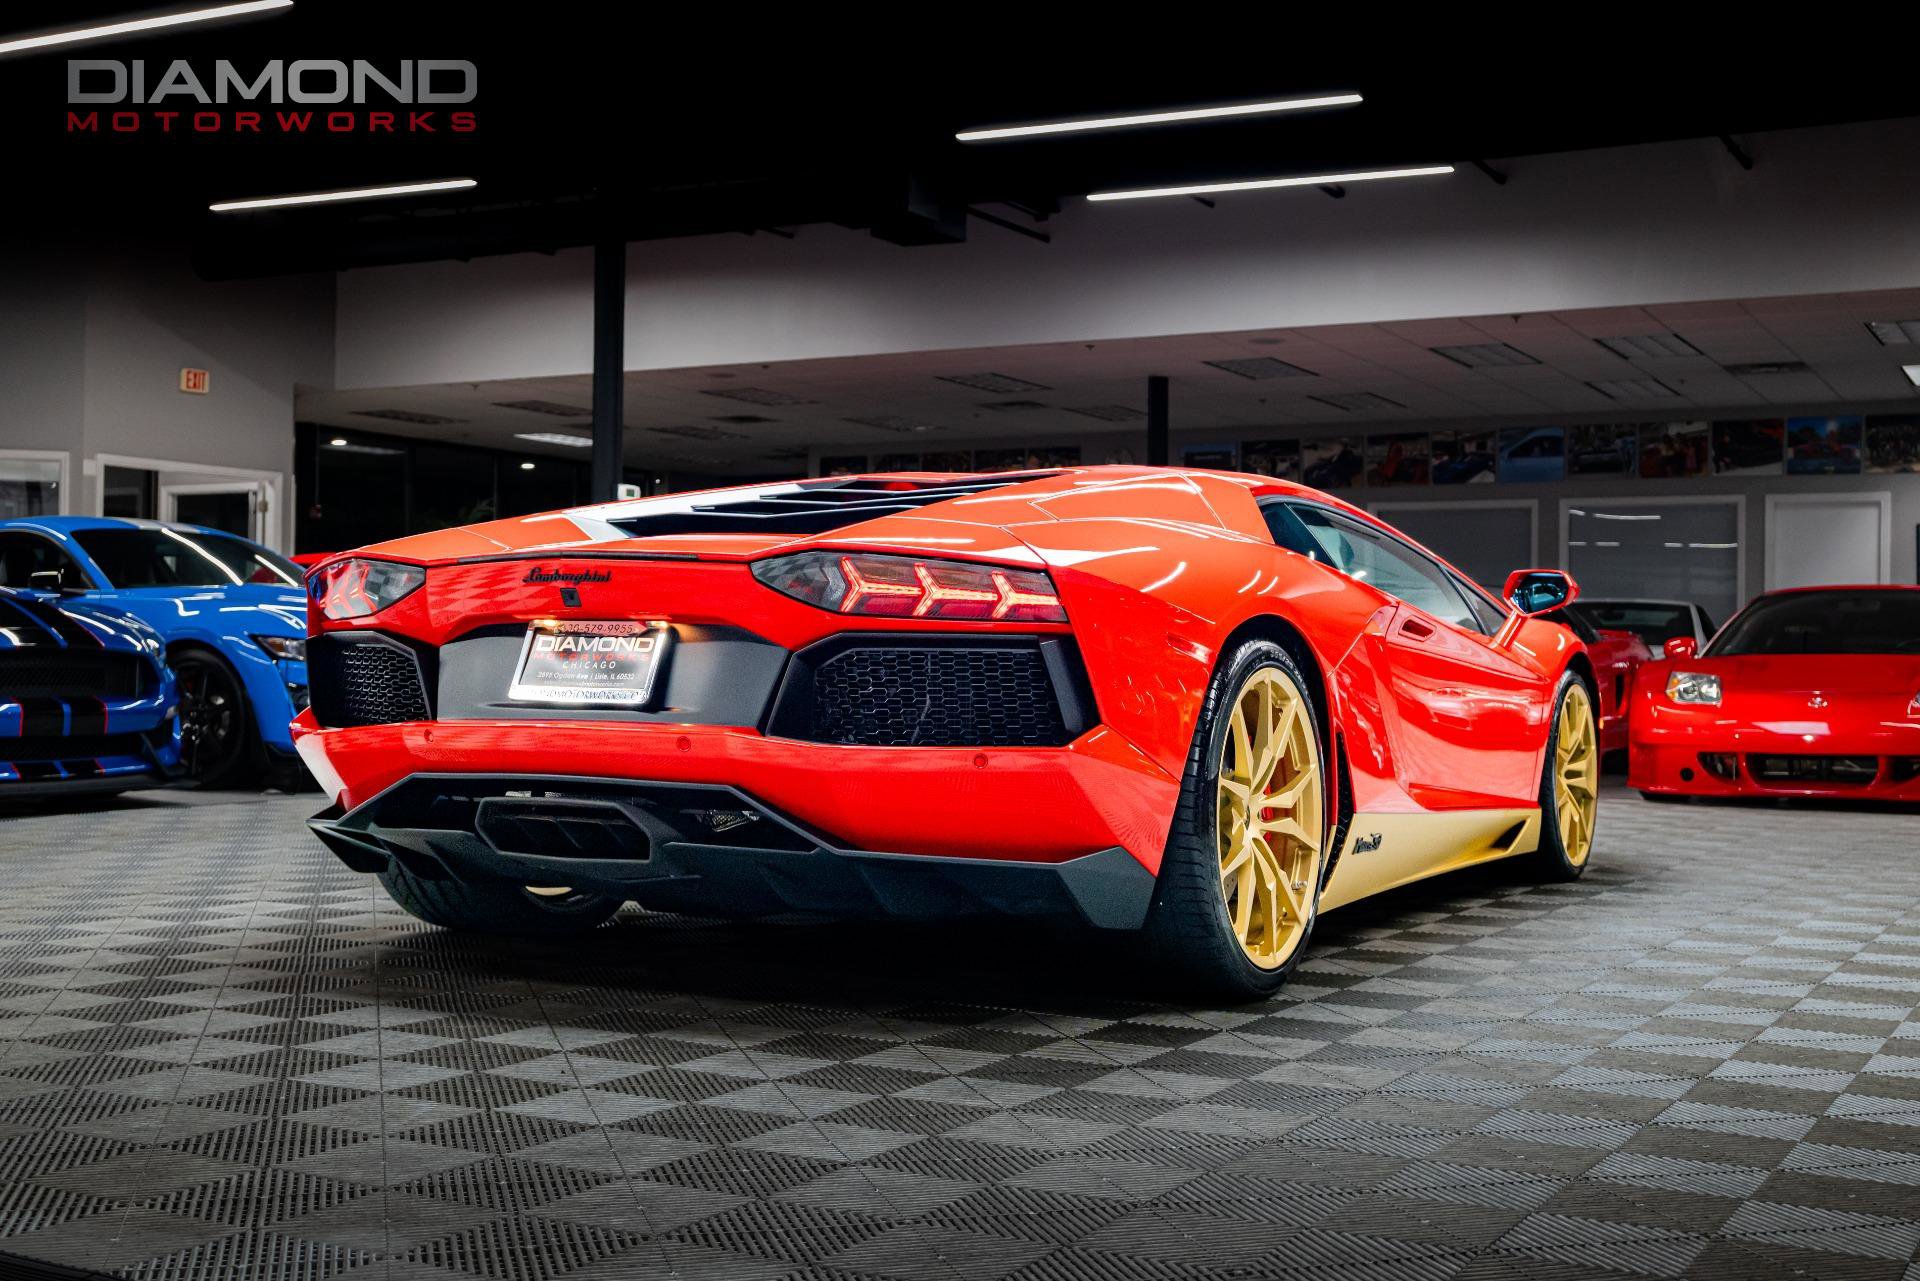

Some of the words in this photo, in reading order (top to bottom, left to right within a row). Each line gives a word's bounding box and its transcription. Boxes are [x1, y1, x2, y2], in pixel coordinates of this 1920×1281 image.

[185, 370, 207, 391] EXIT
[535, 636, 655, 652] DIAMOND
[562, 660, 616, 669] CHICAGO
